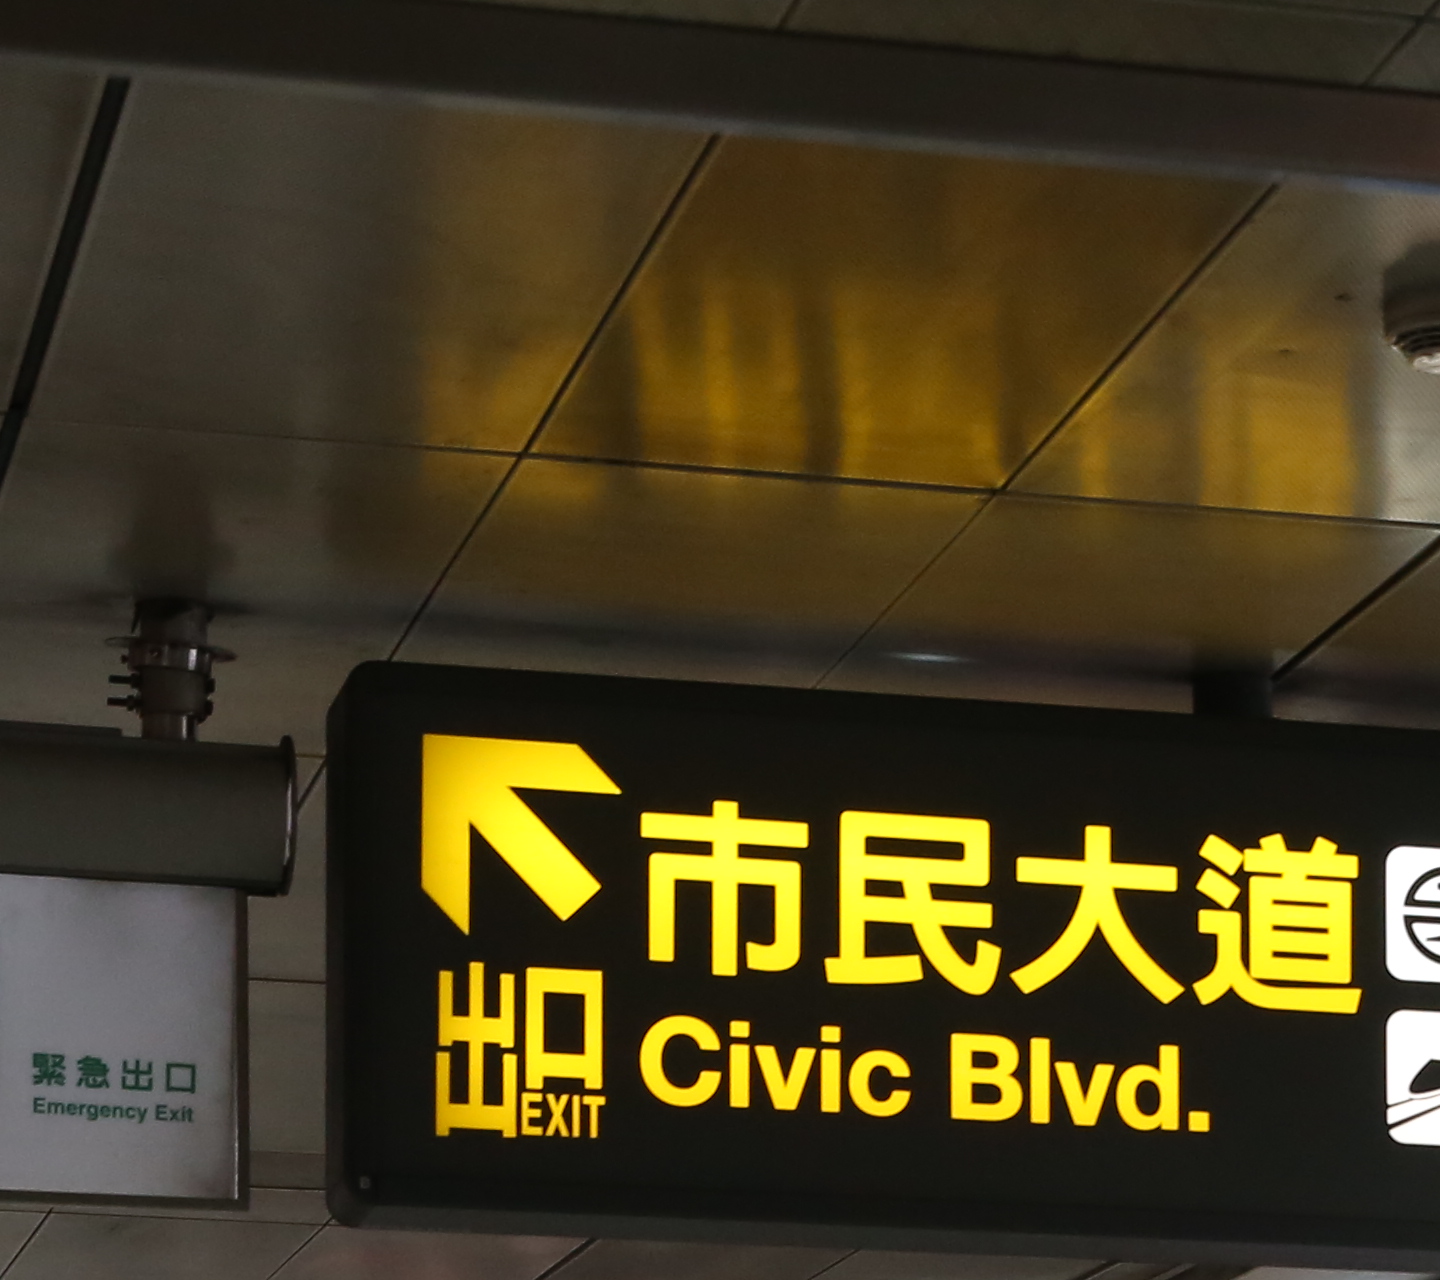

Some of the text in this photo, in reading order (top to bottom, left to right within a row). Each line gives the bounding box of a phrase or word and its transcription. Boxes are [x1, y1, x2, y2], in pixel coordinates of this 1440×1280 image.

[639, 800, 1362, 1014] 市民大道
[32, 1051, 198, 1095] 緊急出口
[436, 961, 604, 1138] 出口
[640, 1015, 1209, 1132] Civic Blvd.
[32, 1097, 194, 1124] Emergency Exit
[521, 1094, 605, 1138] EXIT
